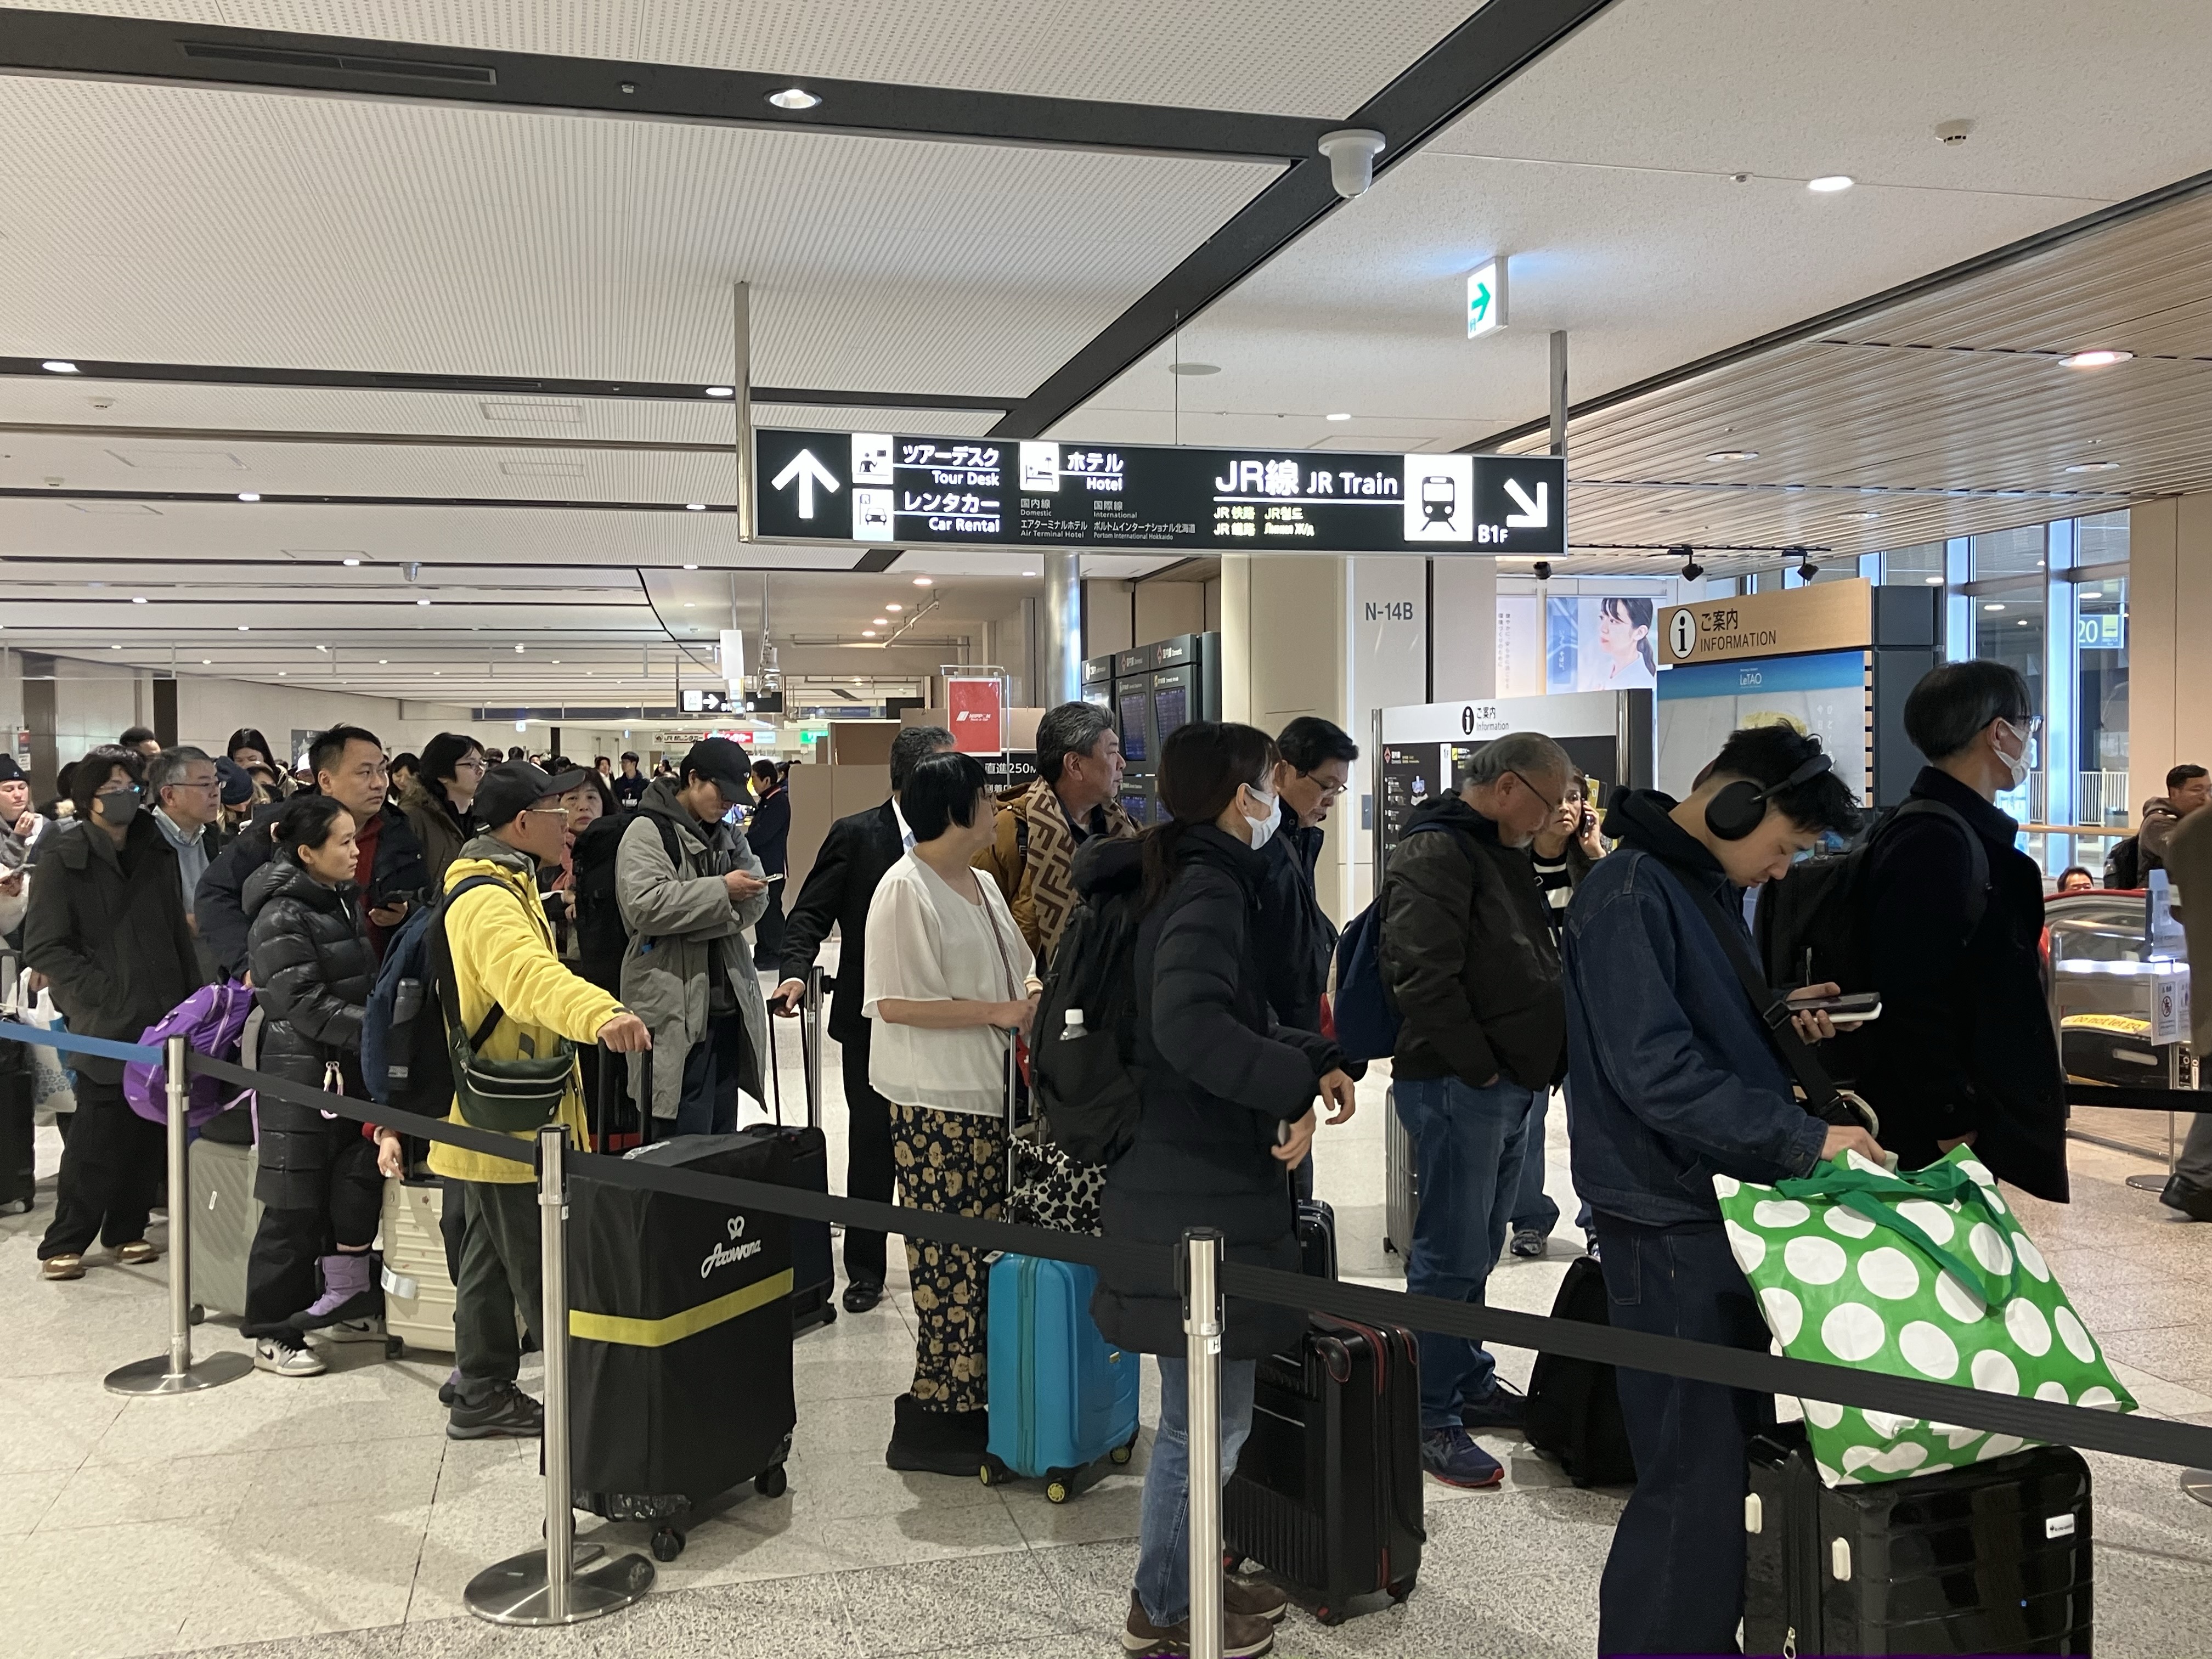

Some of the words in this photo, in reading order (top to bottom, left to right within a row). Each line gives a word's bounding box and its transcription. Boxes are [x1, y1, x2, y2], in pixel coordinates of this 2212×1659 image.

[903, 445, 999, 467] ツアーデスク
[1067, 452, 1124, 472] ホテル
[932, 470, 963, 484] Tour
[967, 472, 999, 486] Desk
[1086, 477, 1122, 490] Hotel
[1215, 459, 1299, 496] JR線
[1306, 471, 1333, 494] JR
[1339, 472, 1398, 495] Train
[905, 491, 1000, 513] レンタカー
[1020, 498, 1051, 509] 国内線
[1093, 500, 1123, 511] 国際線
[1214, 506, 1229, 519] JR
[929, 517, 952, 531] Car
[956, 518, 999, 532] Rental
[1020, 520, 1088, 531] エアターミナルホテル
[1214, 523, 1230, 535] JR
[1478, 524, 1508, 544] B1F
[1365, 602, 1413, 620] N-14B
[1701, 608, 1738, 631] ご案内
[1701, 630, 1776, 652] INFORMATION
[1740, 673, 1762, 686] LeTAO
[1476, 707, 1496, 719] ご案内
[1476, 720, 1509, 731] Information
[2109, 1018, 2126, 1027] let
